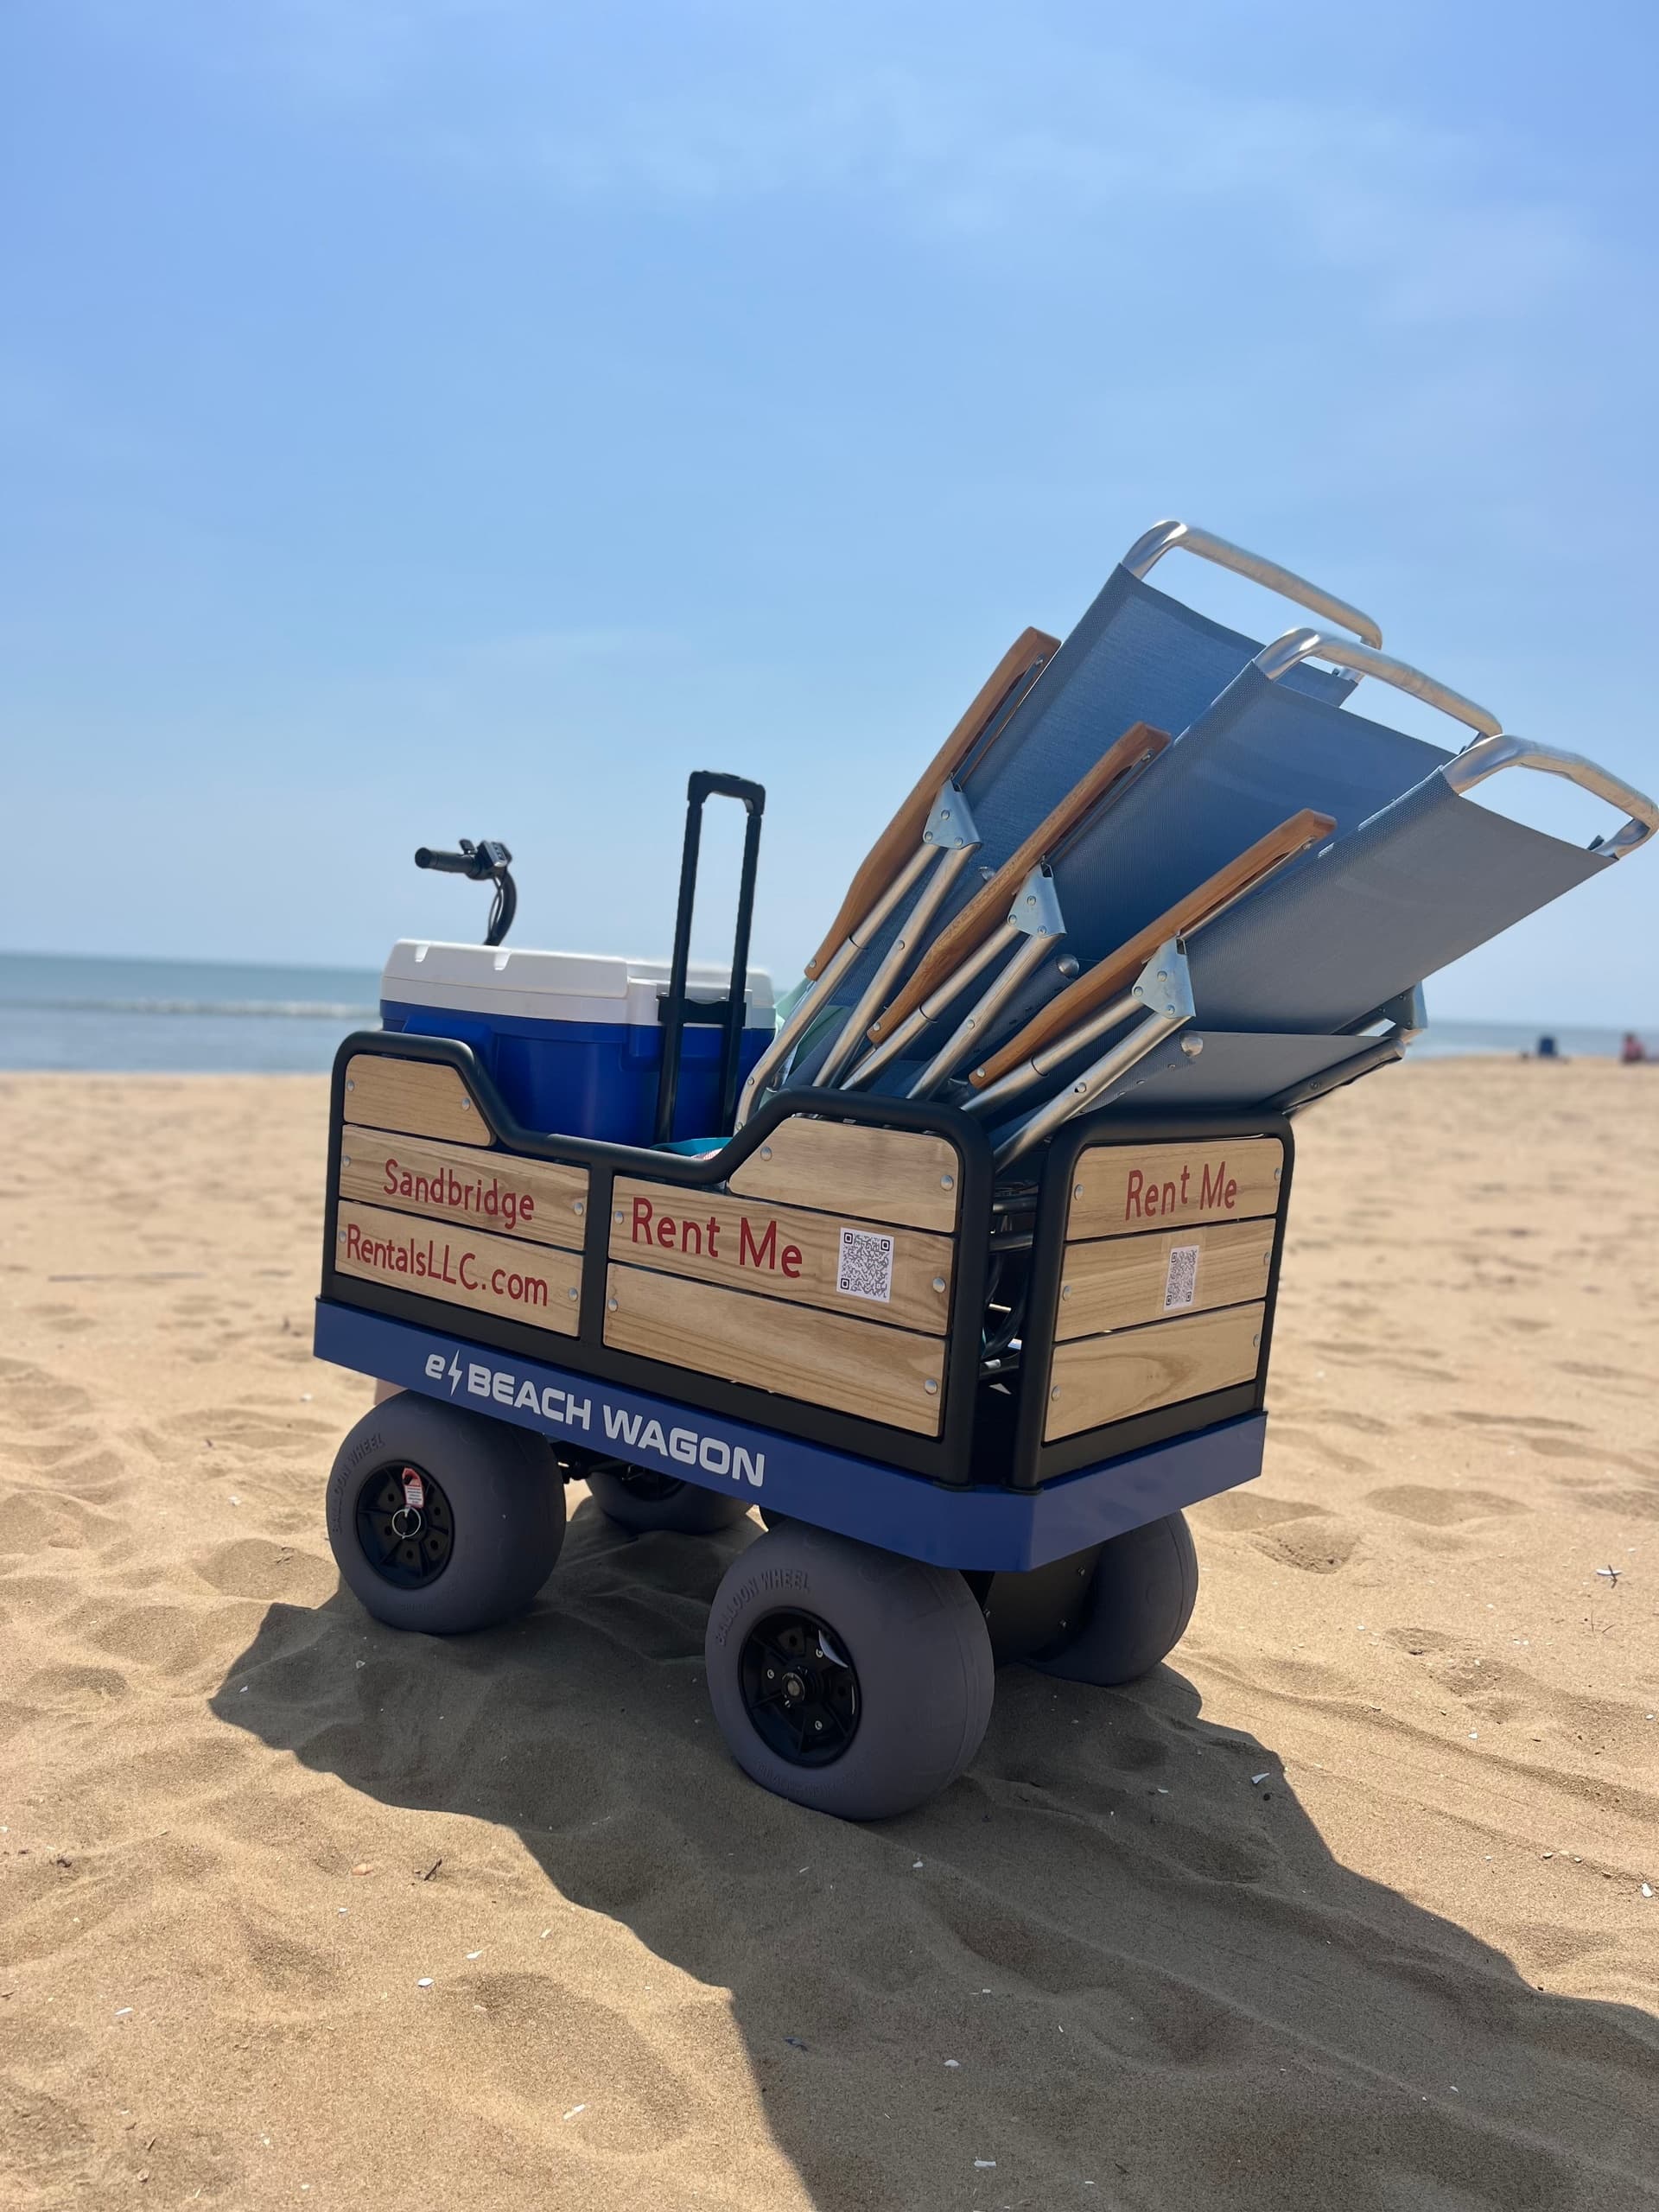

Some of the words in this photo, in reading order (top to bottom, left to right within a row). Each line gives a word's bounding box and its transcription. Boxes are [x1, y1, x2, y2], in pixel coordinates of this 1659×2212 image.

[384, 1159, 534, 1229] Sandbridge
[1125, 1164, 1190, 1221] Rent
[1199, 1160, 1237, 1211] Me
[346, 1224, 548, 1306] RentalsLLC.com
[632, 1198, 720, 1258] Rent
[739, 1217, 804, 1278] Me
[347, 1433, 386, 1466] WHEEL
[467, 1363, 592, 1431] BEACH
[603, 1405, 766, 1487] WAGON
[715, 1576, 760, 1647] BALLOON
[760, 1568, 810, 1593] WHEEL
